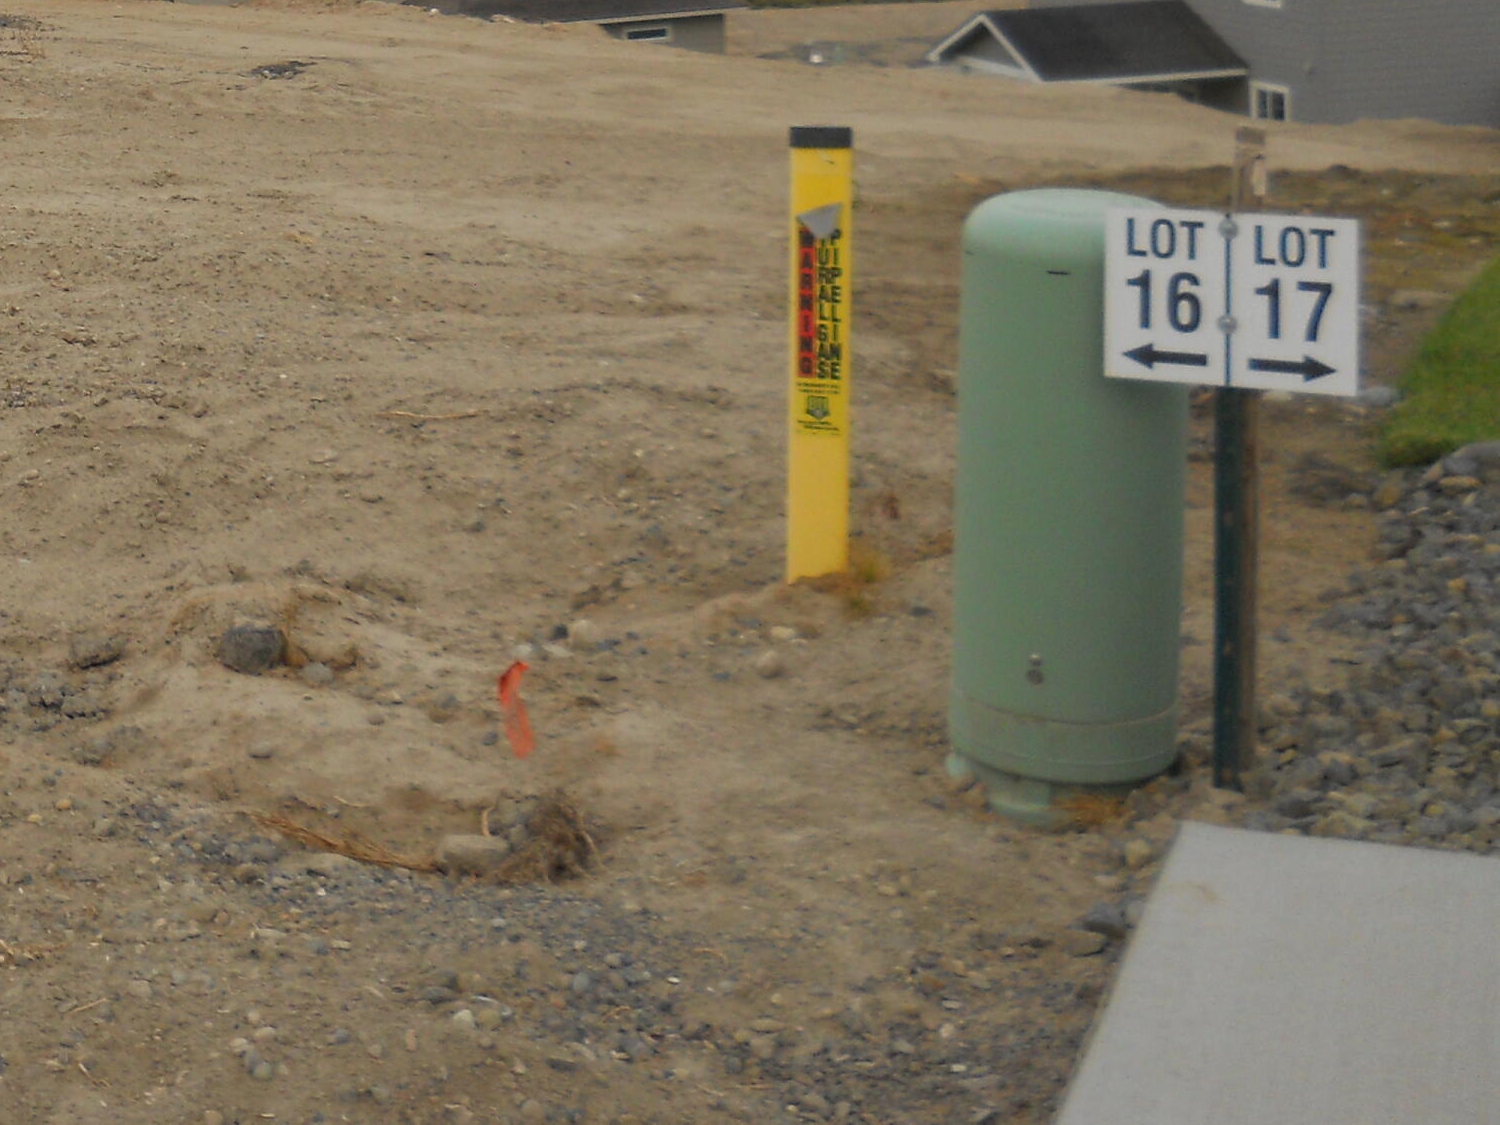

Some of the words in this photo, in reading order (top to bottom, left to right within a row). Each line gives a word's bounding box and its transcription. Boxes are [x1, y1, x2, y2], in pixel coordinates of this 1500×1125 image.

[1125, 217, 1204, 261] LOT
[1254, 225, 1336, 269] LOT
[830, 228, 842, 380] PIPELINE
[1126, 269, 1202, 333] 16
[1254, 277, 1333, 342] 17
